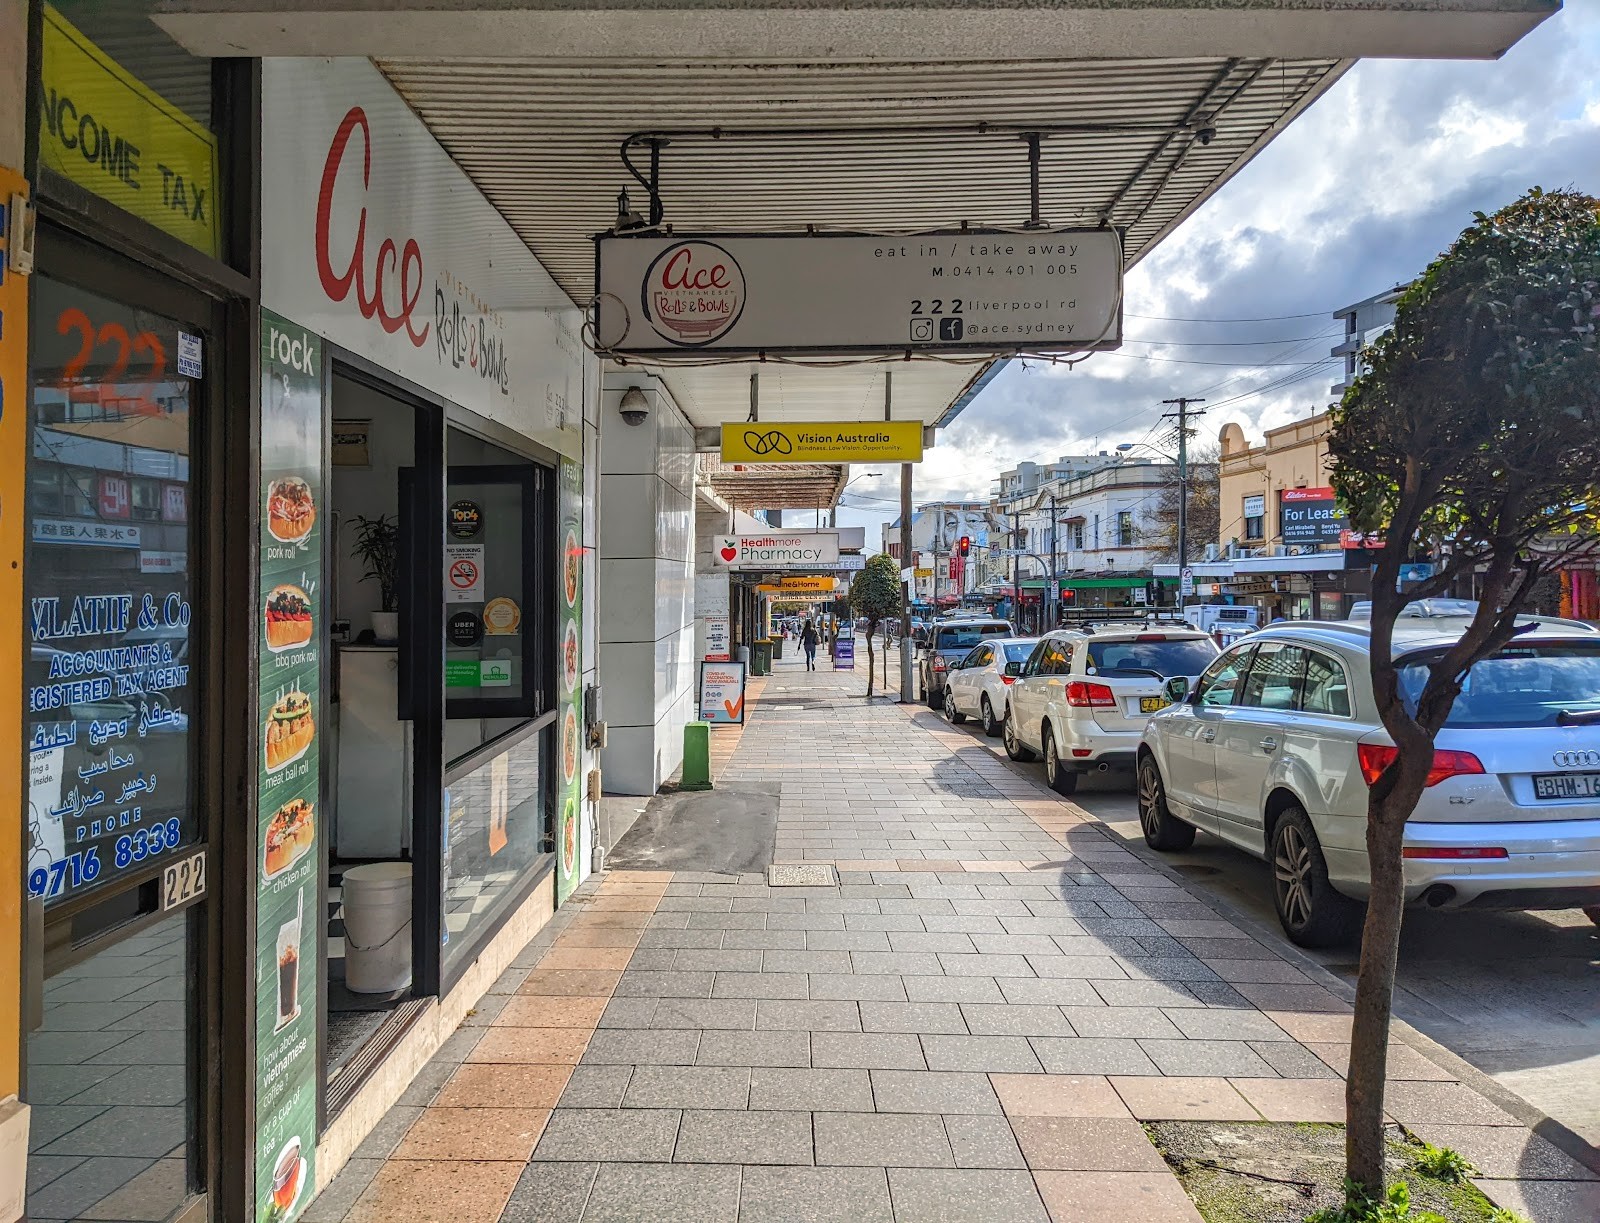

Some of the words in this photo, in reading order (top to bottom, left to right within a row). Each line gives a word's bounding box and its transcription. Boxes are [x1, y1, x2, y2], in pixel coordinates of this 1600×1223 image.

[157, 163, 208, 227] TAX
[874, 245, 906, 257] eat
[920, 244, 937, 256] in
[970, 243, 1014, 256] take
[1028, 244, 1078, 257] away
[1006, 265, 1035, 275] 401
[1047, 264, 1077, 275] 005
[911, 299, 963, 314] 222
[969, 300, 1049, 312] liverpool
[1060, 299, 1076, 309] rd
[967, 322, 1075, 335] @ace.sydney
[270, 327, 315, 376] rock
[797, 433, 832, 443] Vision
[836, 433, 890, 443] Australia
[1284, 508, 1304, 521] For
[1307, 508, 1344, 520] Lease
[267, 546, 284, 560] pork
[285, 545, 296, 559] roll
[741, 537, 801, 547] Healthmore
[741, 547, 822, 561] Pharmacy
[138, 593, 158, 631] &
[164, 592, 191, 628] Co
[49, 644, 160, 680] ACCOUNTANTS
[162, 641, 172, 664] &
[275, 653, 290, 670] bbq
[290, 651, 307, 668] pork
[306, 648, 317, 664] roll
[115, 672, 144, 698] TAX
[146, 665, 190, 692] AGENT
[78, 748, 134, 783] محاسب
[265, 771, 284, 789] meat
[285, 763, 299, 780] ball
[299, 759, 309, 775] roll
[115, 771, 156, 803] وخبير
[49, 785, 105, 822] ضرائب
[76, 806, 141, 842] PHONE
[28, 846, 100, 900] 9716
[115, 817, 181, 869] 8338
[166, 856, 204, 906] 222
[273, 866, 299, 894] chicken
[299, 860, 311, 879] roll
[263, 1046, 279, 1069] how
[279, 1027, 299, 1053] about
[263, 1037, 307, 1088] vietnamese
[263, 1082, 284, 1108] coffee
[278, 1098, 292, 1119] cup
[292, 1086, 301, 1105] of
[263, 1136, 276, 1158] tea
